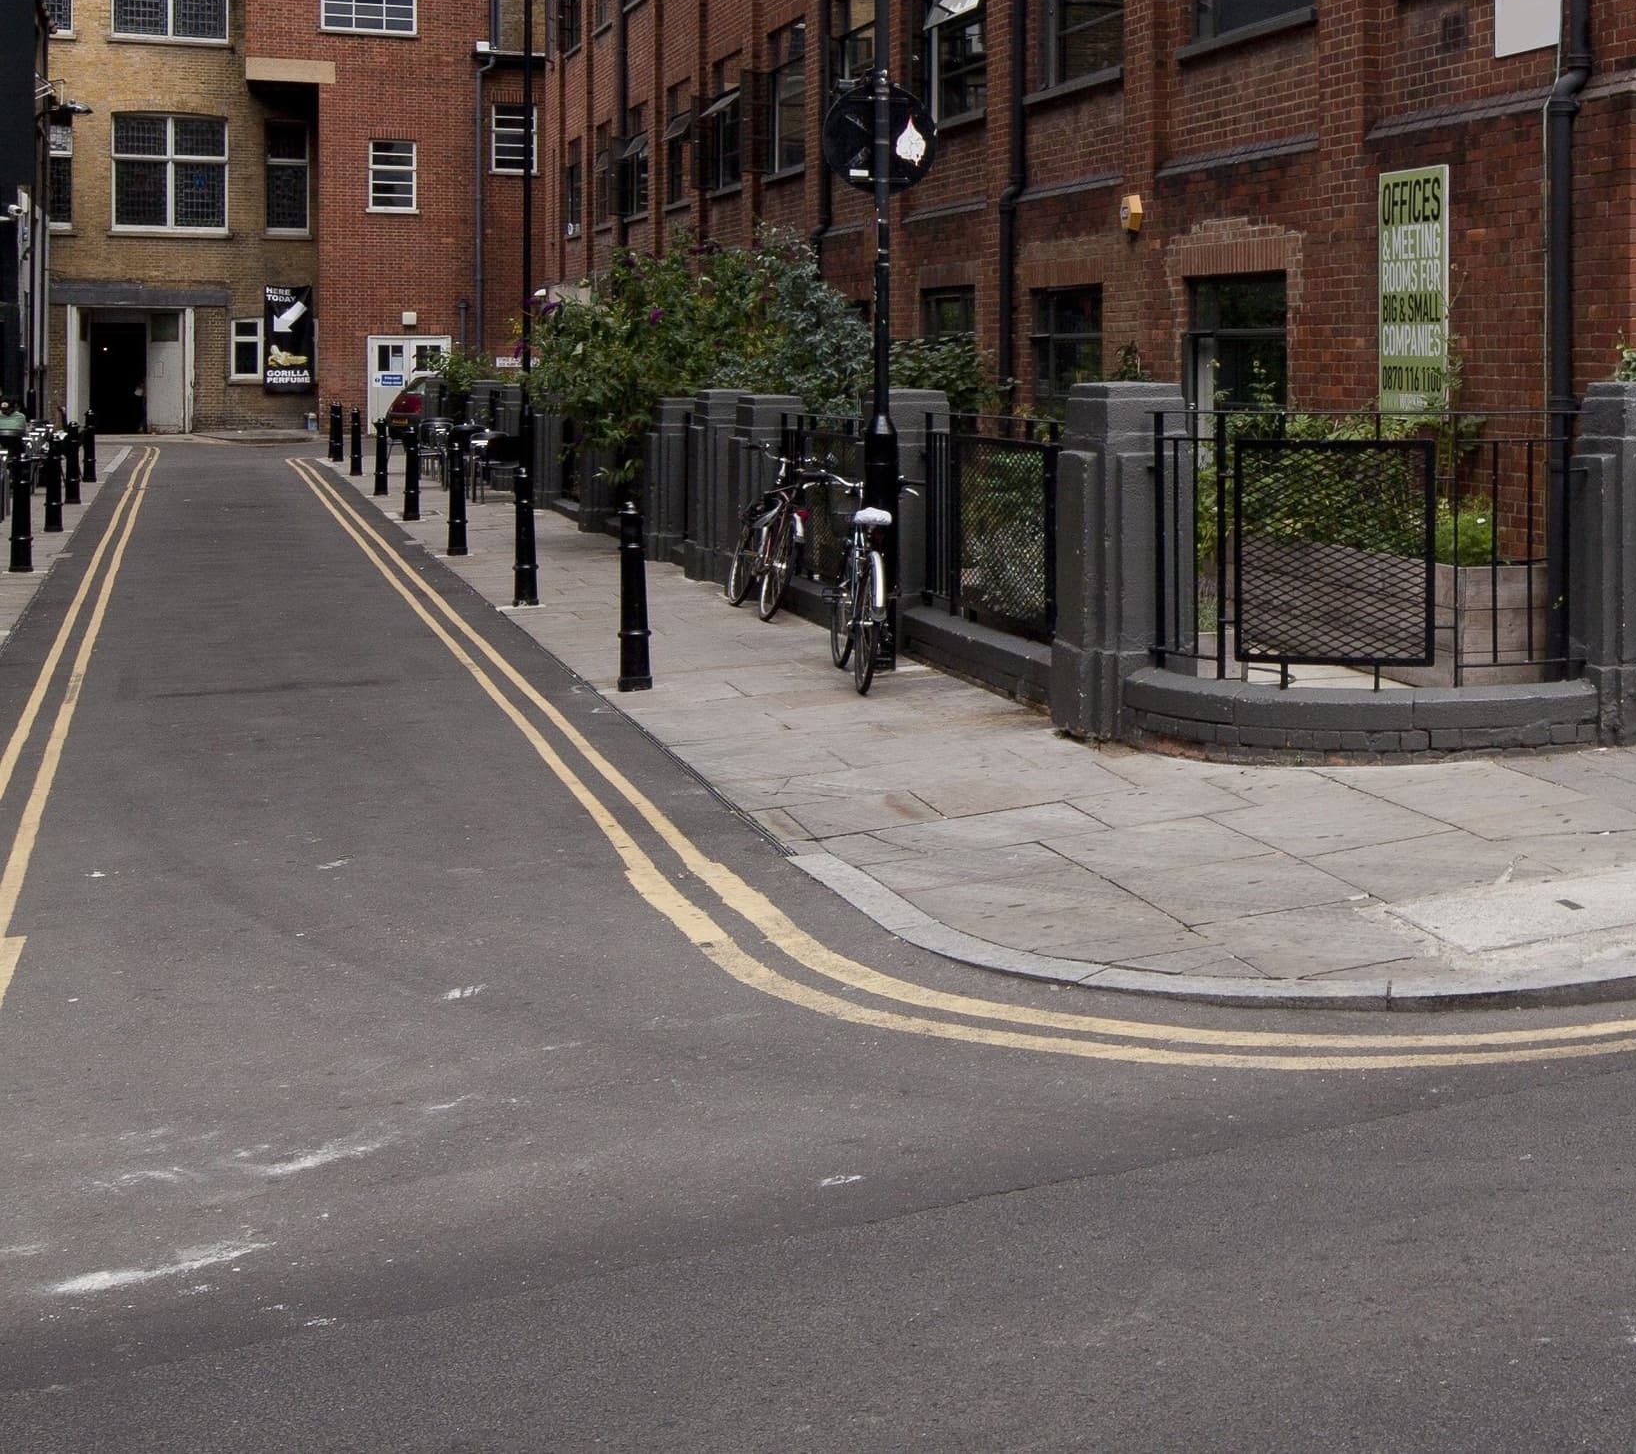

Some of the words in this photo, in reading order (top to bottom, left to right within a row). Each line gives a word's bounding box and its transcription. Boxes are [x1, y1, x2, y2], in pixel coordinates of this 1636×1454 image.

[1382, 176, 1441, 226] OFFICES
[1383, 230, 1391, 261] &
[1392, 223, 1441, 259] MEETING
[266, 287, 291, 295] HERE
[1383, 260, 1418, 293] ROOMS
[1421, 258, 1441, 291] FOR
[266, 294, 296, 302] TODAY
[1383, 294, 1397, 323] BIG
[1399, 297, 1406, 323] &
[1408, 293, 1441, 323] SMALL
[1383, 324, 1441, 357] COMPANIES
[1383, 366, 1403, 391] 0870
[1405, 366, 1419, 392] 116
